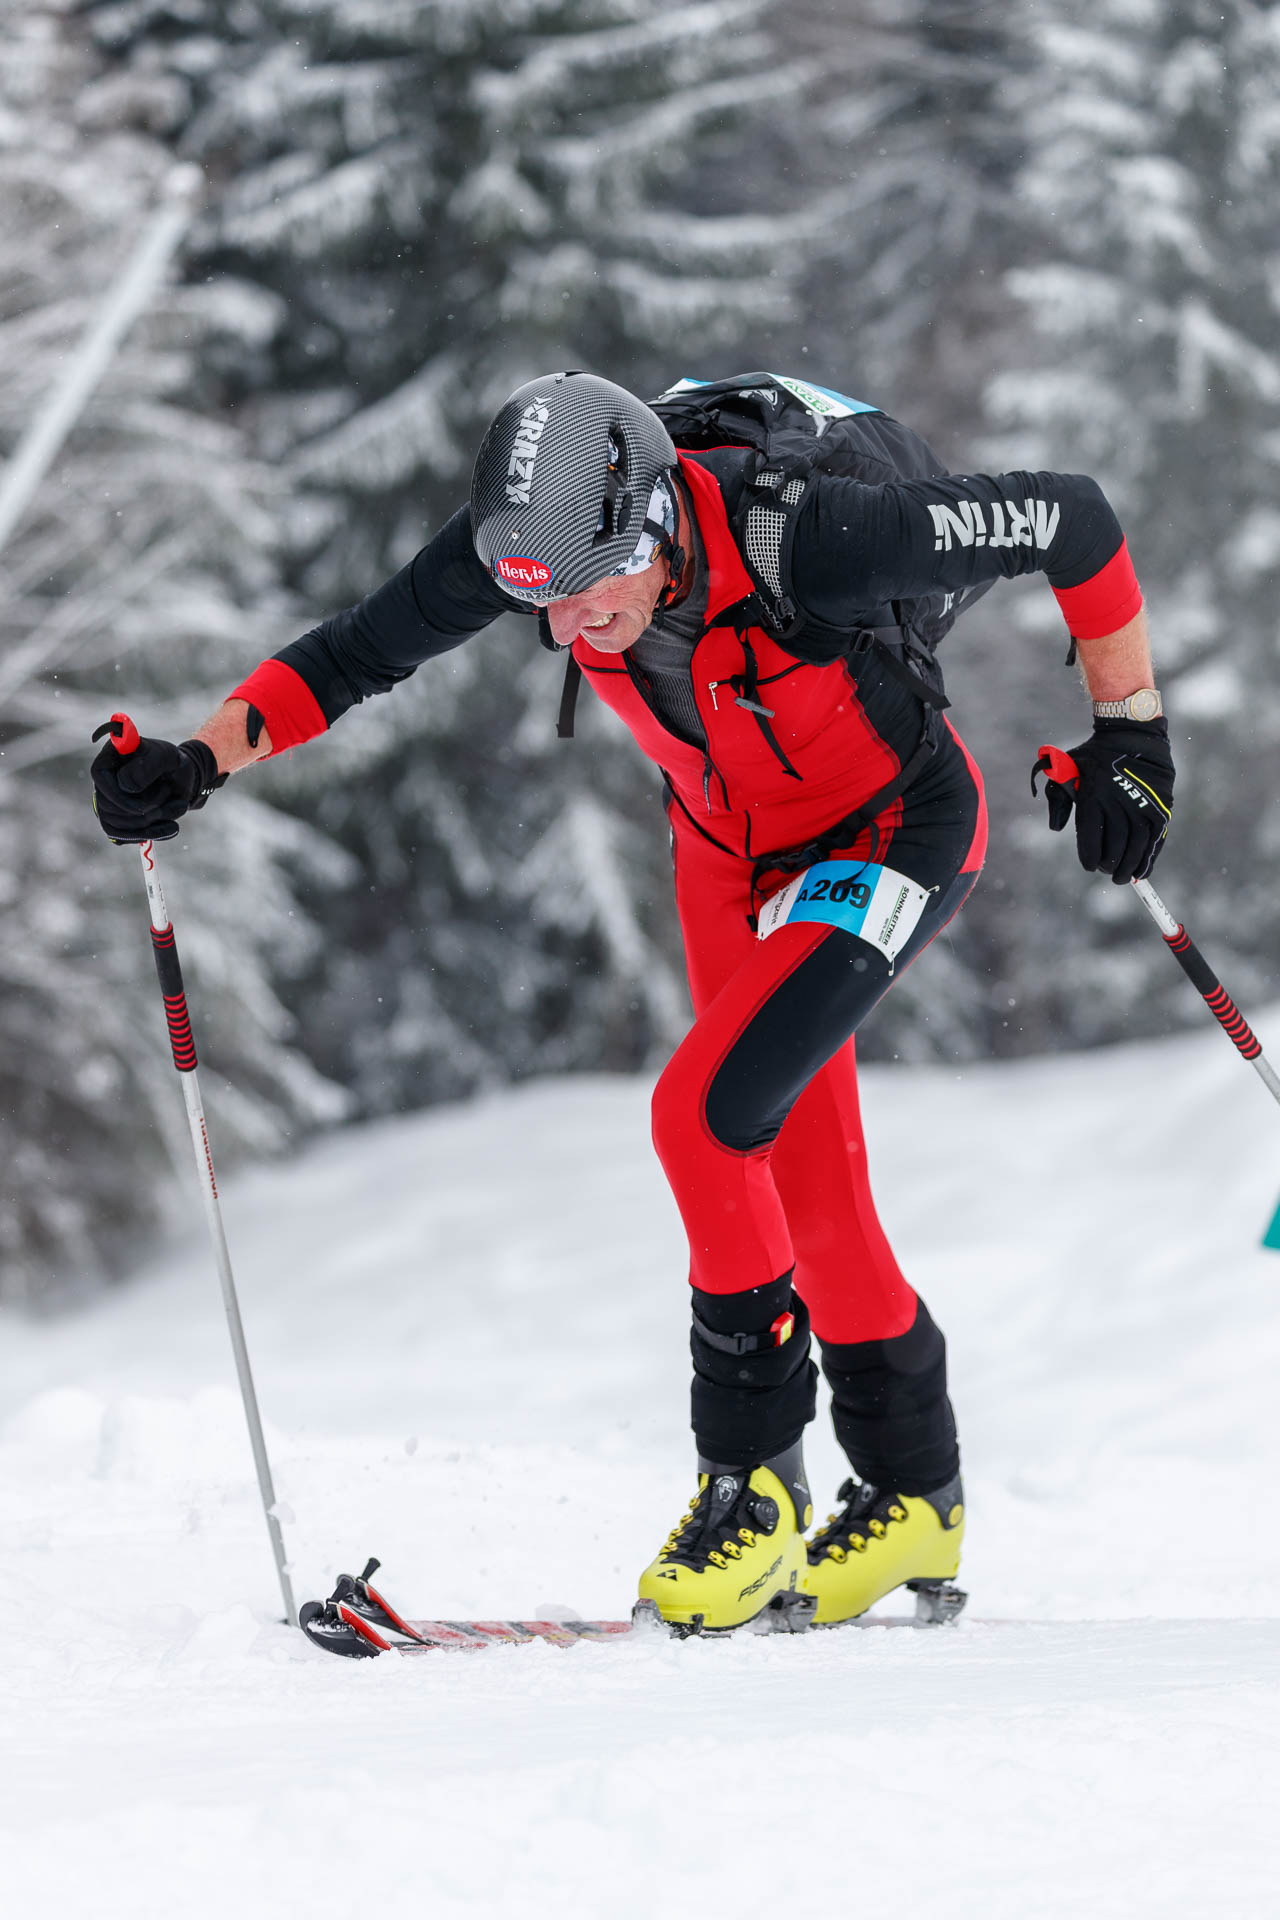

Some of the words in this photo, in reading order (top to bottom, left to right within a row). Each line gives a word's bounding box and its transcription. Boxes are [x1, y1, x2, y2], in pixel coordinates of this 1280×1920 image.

[506, 397, 553, 505] CRAZY
[498, 560, 549, 583] Hervis
[1112, 775, 1149, 809] LEKI
[882, 886, 910, 946] SONNLEITNER
[738, 1554, 783, 1602] FISCHER
